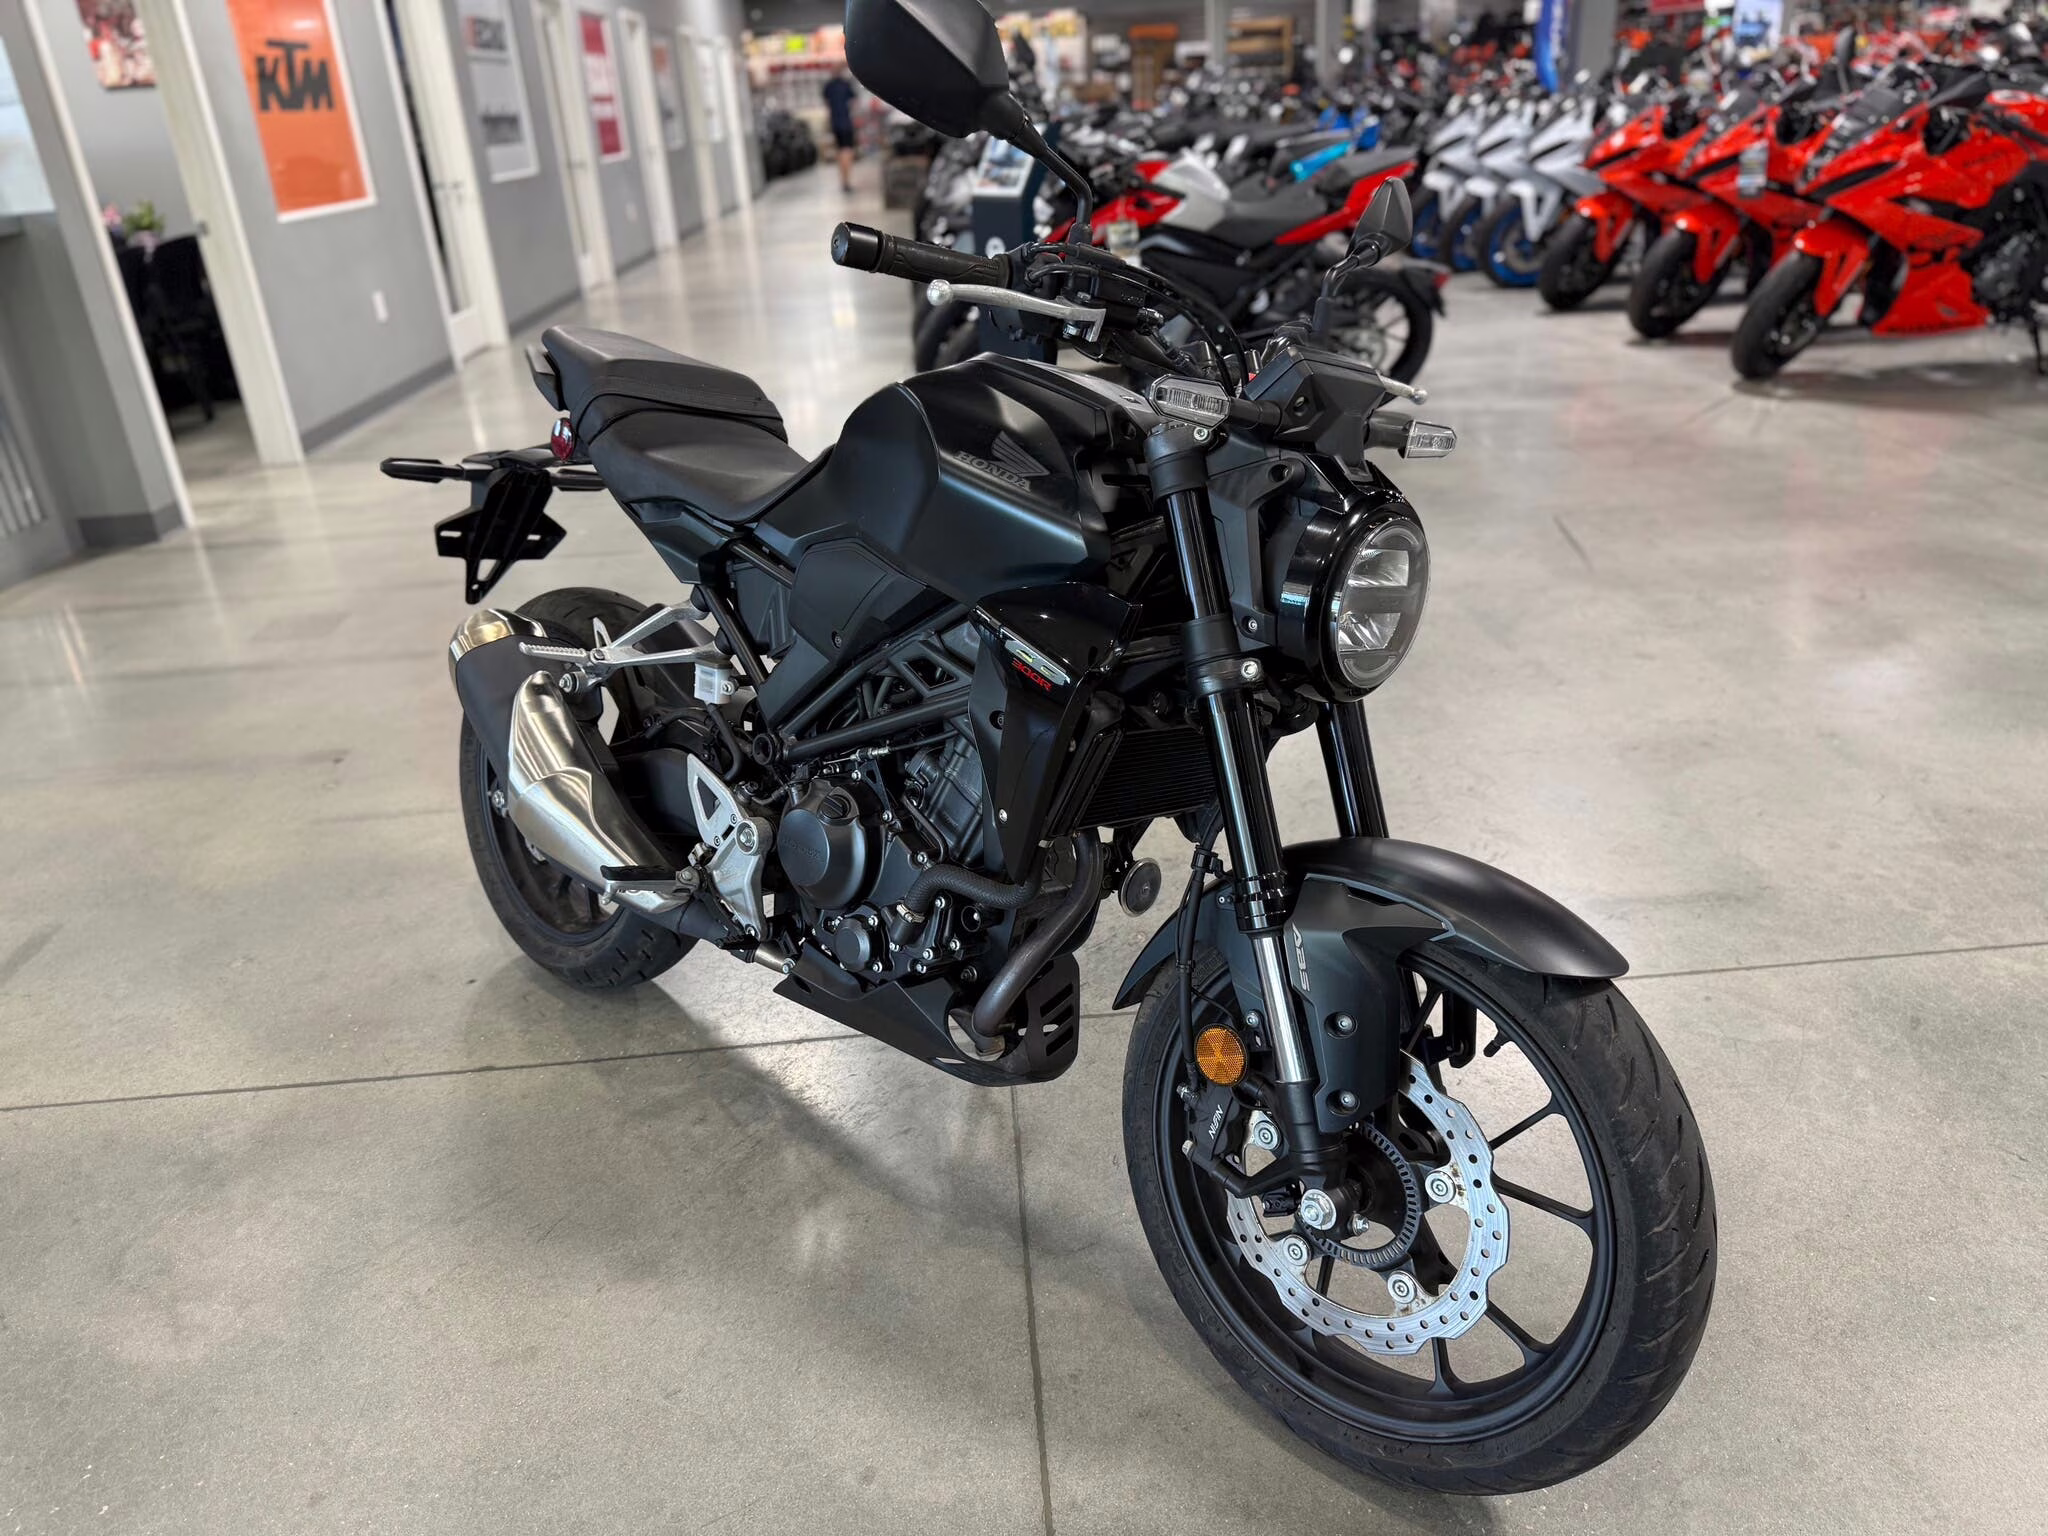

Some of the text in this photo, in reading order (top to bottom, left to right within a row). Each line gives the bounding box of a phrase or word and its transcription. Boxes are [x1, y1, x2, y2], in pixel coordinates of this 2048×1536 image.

[255, 38, 334, 111] KTM
[954, 450, 1031, 493] HONDA
[1012, 657, 1052, 692] 300R
[1292, 922, 1310, 992] ABS
